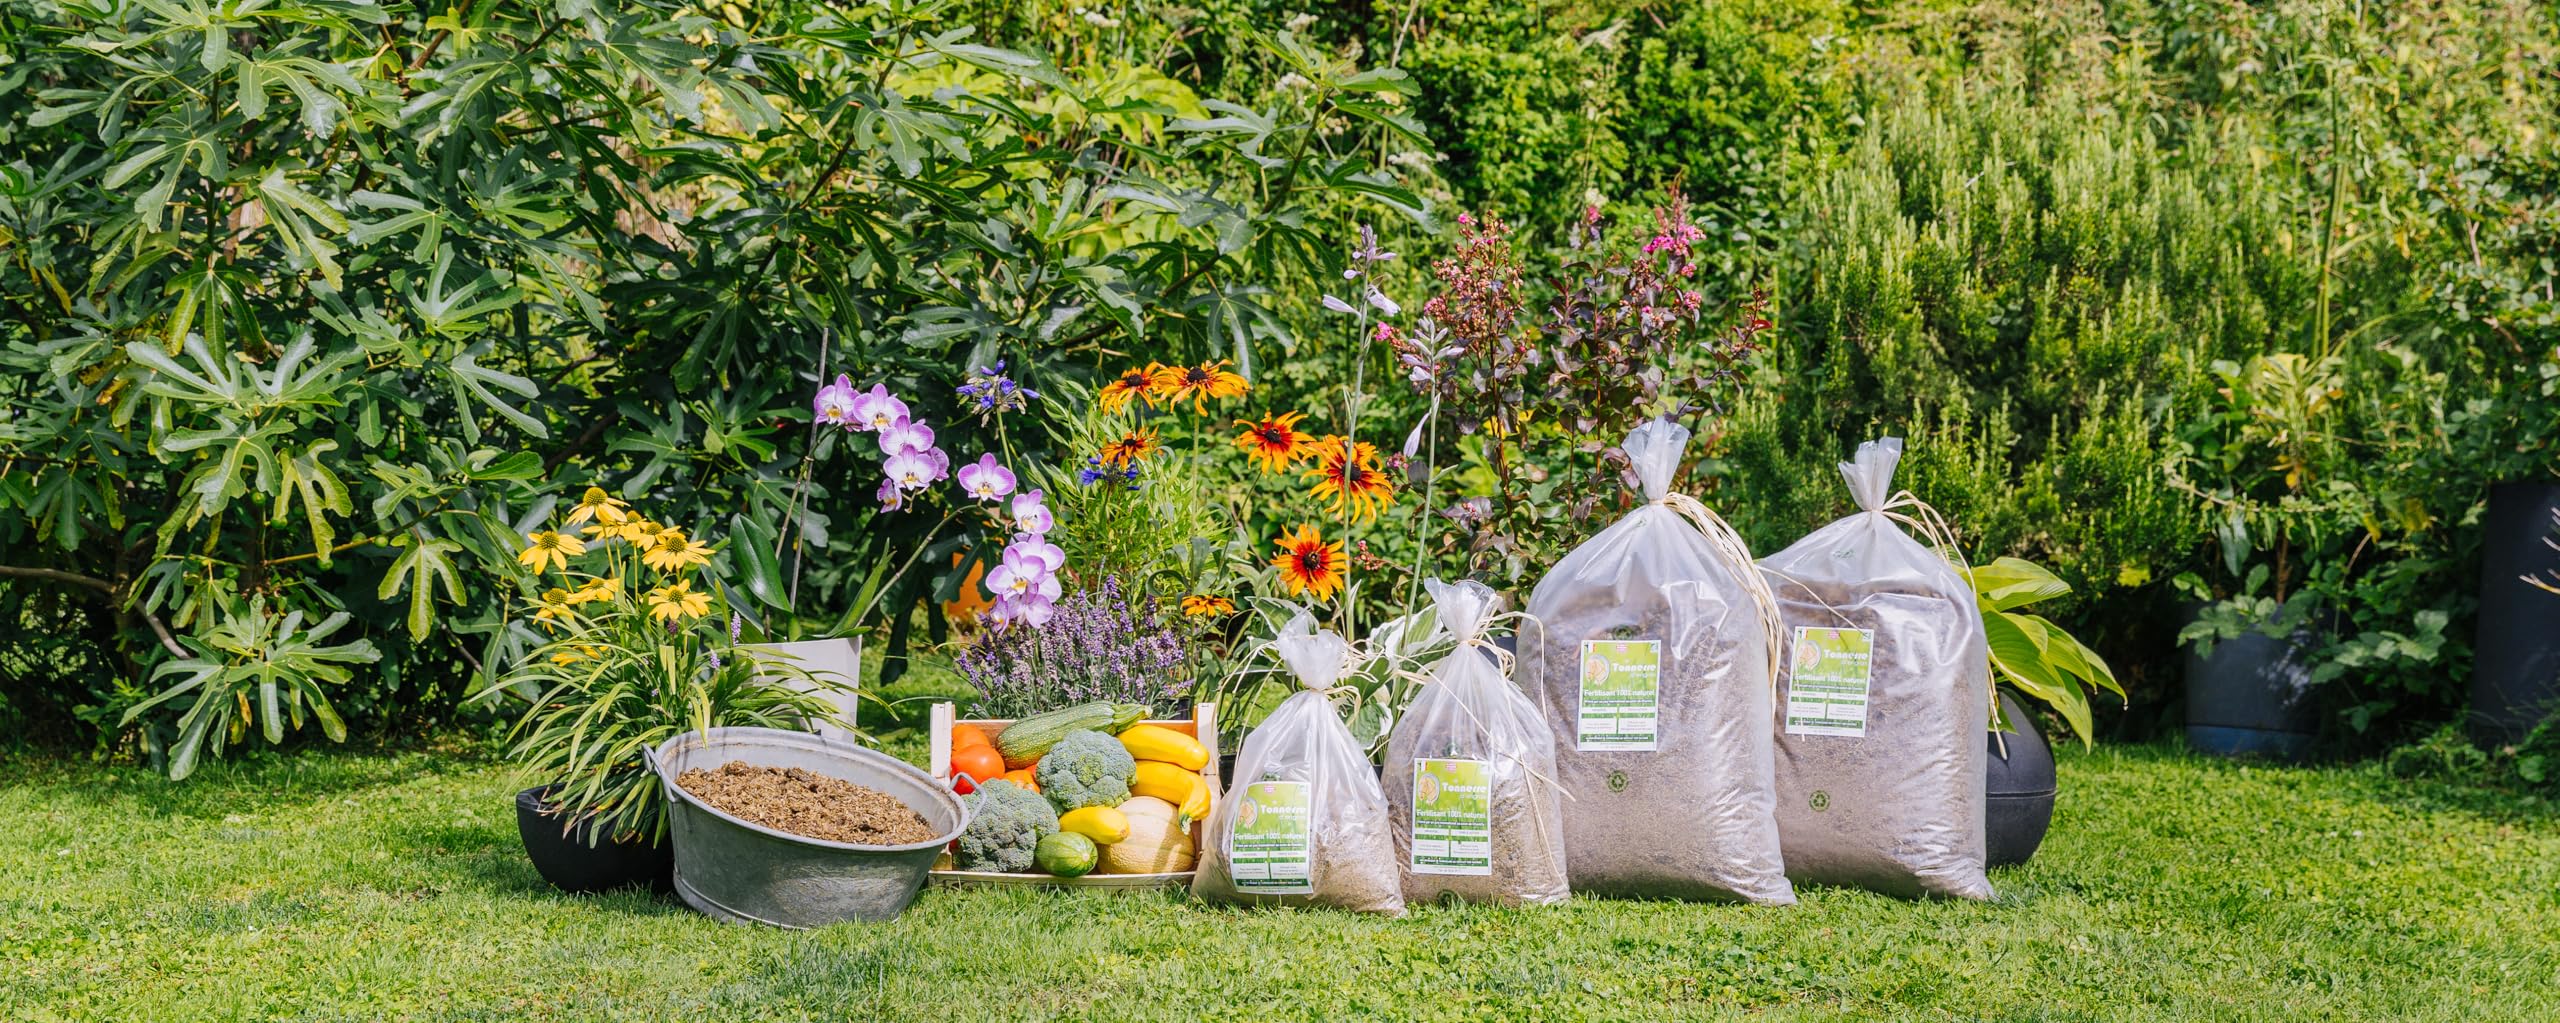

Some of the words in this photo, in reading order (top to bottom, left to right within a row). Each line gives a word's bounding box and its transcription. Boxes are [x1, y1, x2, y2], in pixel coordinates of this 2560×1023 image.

[1612, 663, 1657, 673] Tonnerre
[1632, 689, 1655, 697] naturel
[1441, 782, 1487, 793] Tonnerre
[1260, 804, 1307, 814] Tonnerre
[1416, 809, 1446, 818] Fertilisant
[1463, 811, 1486, 819] naturel
[1235, 832, 1265, 840] Fertilisant
[1281, 832, 1305, 840] naturel
